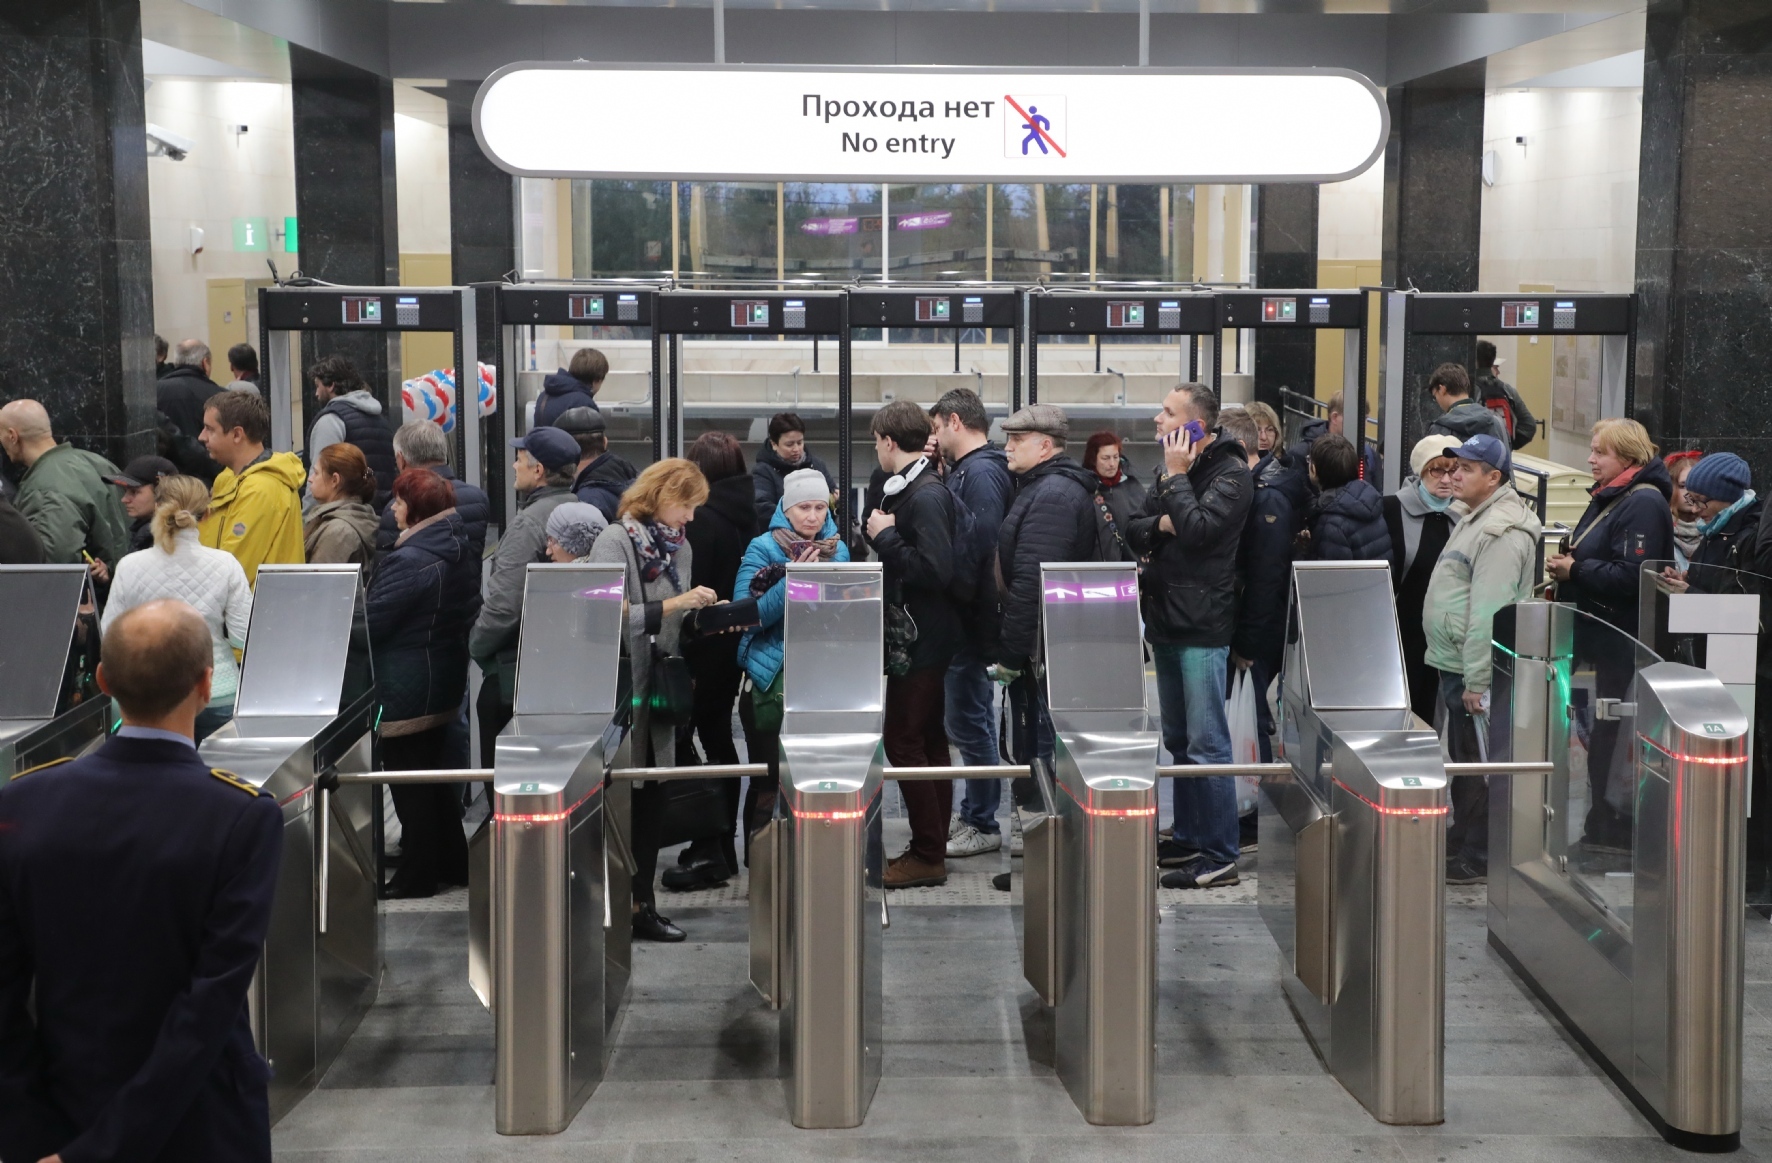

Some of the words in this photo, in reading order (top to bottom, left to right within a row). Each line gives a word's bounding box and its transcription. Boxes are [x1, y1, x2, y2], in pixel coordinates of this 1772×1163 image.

[802, 94, 935, 124] Прохода
[944, 100, 996, 119] нет
[841, 132, 878, 153] No
[886, 133, 956, 160] entry
[1706, 724, 1724, 733] 1A
